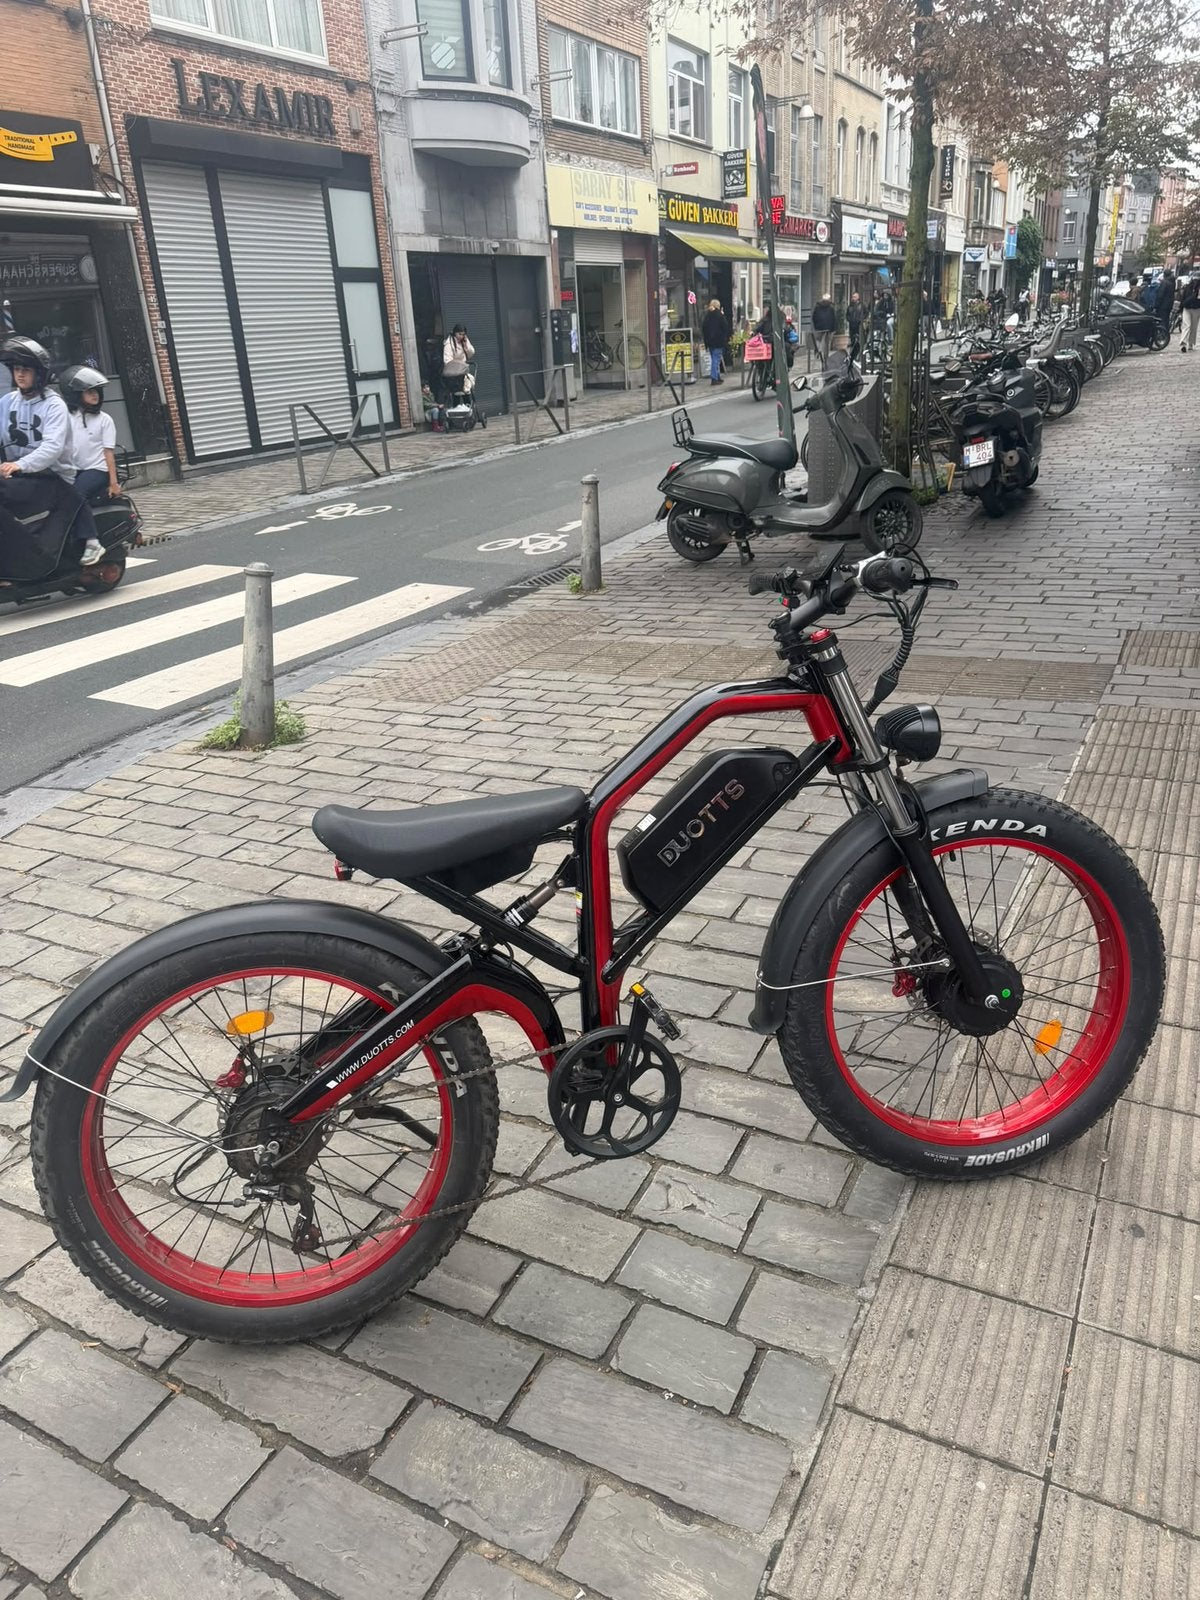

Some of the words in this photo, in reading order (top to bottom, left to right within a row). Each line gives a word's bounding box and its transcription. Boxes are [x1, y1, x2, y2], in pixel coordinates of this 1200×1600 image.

[171, 58, 337, 136] LEXAMIR
[4, 135, 36, 144] TRADITIONAL
[7, 143, 36, 151] HANDMADE
[573, 171, 612, 199] SARAY
[668, 193, 700, 223] GÜVEN
[976, 450, 993, 461] 404
[657, 778, 745, 868] DUOTTS
[335, 1019, 415, 1083] WWW.DUOTTS.COM
[963, 1138, 1037, 1167] KRUSADE
